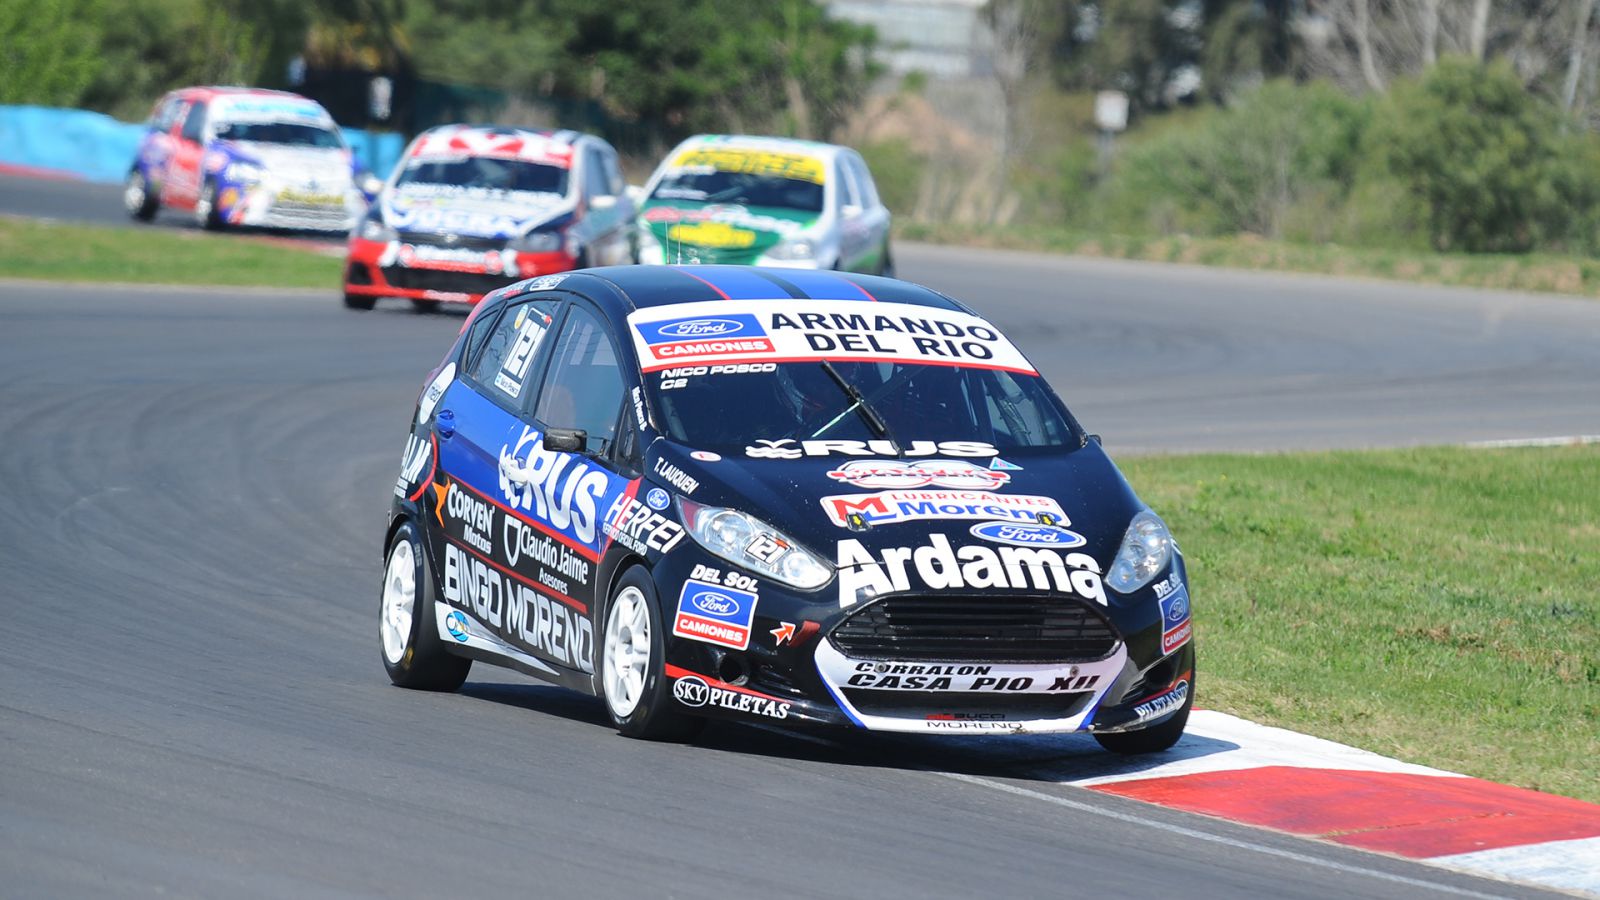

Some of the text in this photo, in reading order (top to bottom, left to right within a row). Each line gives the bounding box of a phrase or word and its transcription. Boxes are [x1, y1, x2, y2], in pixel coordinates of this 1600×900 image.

[676, 320, 728, 336] Ford
[771, 312, 999, 342] ARMANDO
[658, 339, 769, 357] CAMIONES
[804, 333, 994, 360] DEL RIO
[659, 362, 777, 380] NICO POSCO
[801, 438, 1000, 458] RUS
[653, 456, 700, 495] T. LAUQUEN
[447, 483, 494, 540] CORVEN
[891, 492, 1051, 508] LUBRICANTES
[463, 525, 492, 555] Motos
[998, 524, 1061, 544] Ford
[520, 525, 589, 586] Claudio Jaime
[538, 567, 569, 596] Asesores
[690, 564, 759, 593] DEL SOL
[836, 532, 1110, 610] Ardama
[1152, 579, 1173, 599] DEL
[444, 543, 595, 675] BINGO MORENO
[699, 594, 731, 614] Ford
[679, 618, 744, 643] CAMIONES
[855, 661, 992, 677] CORRALON
[846, 673, 1102, 691] CASA PIO XII
[675, 680, 791, 720] SKY PILETAS
[927, 721, 1023, 730] MORENO
